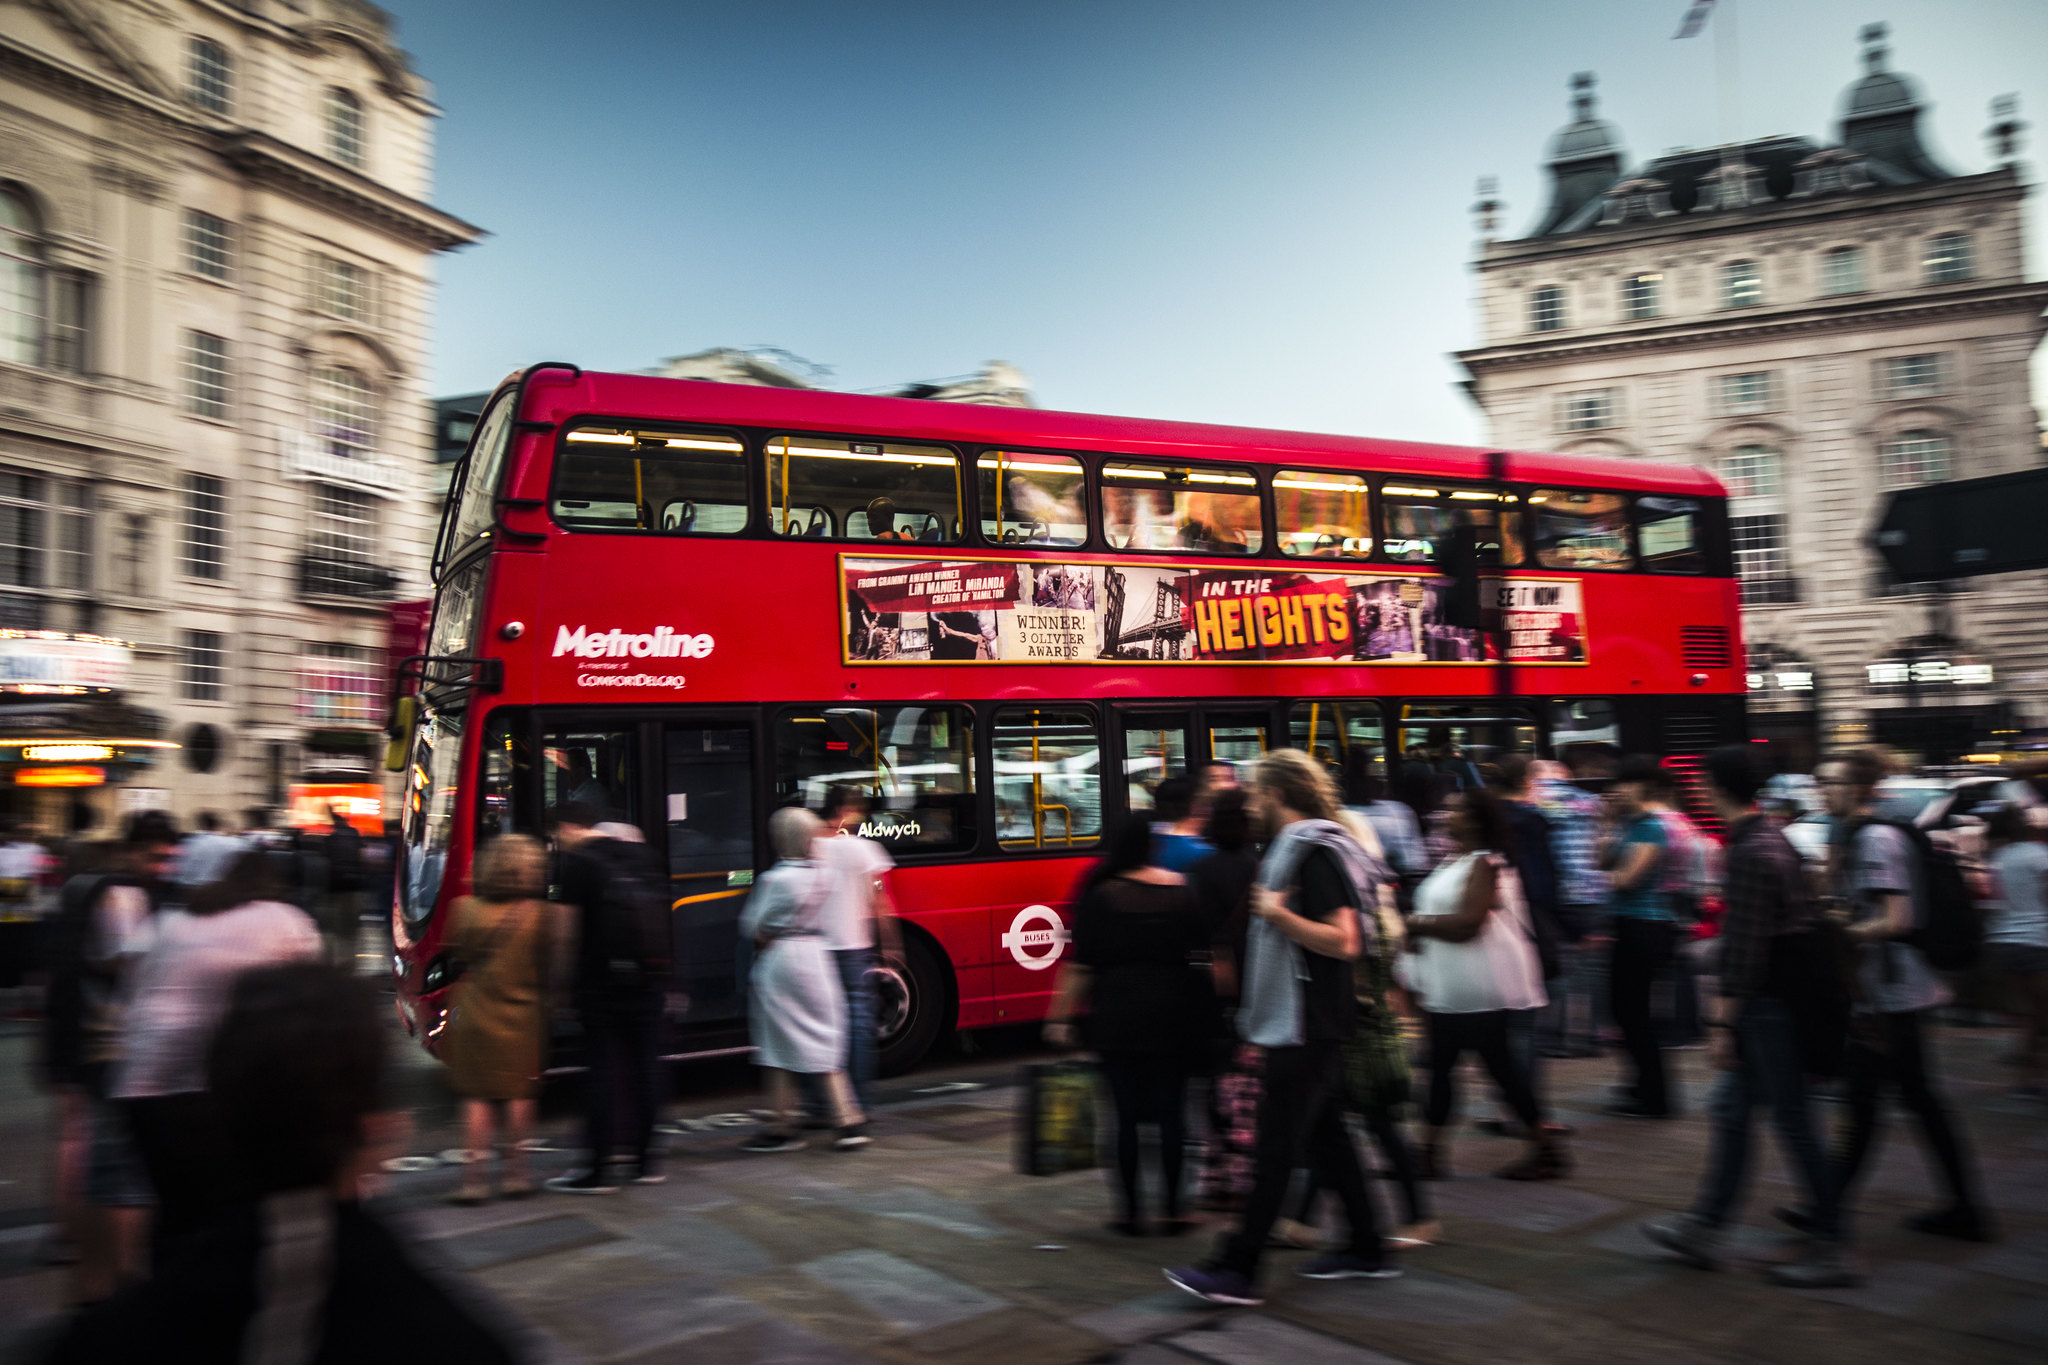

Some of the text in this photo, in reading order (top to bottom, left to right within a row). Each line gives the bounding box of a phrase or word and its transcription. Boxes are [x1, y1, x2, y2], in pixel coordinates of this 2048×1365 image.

[857, 578, 878, 589] FROM
[878, 574, 908, 587] GRAMMY
[909, 572, 933, 584] AWARD
[926, 580, 963, 595] MANUEL
[1202, 578, 1273, 597] IN THE
[932, 594, 961, 605] CREATOR
[962, 591, 970, 602] OF
[1016, 614, 1086, 630] WINNER!
[1194, 593, 1350, 654] HEIGHTS
[551, 624, 715, 659] Metroline
[1019, 631, 1085, 645] 3 OLIVIER
[1028, 645, 1079, 657] AWARDS
[857, 820, 921, 840] Aldwych
[1024, 932, 1050, 943] BUSES
